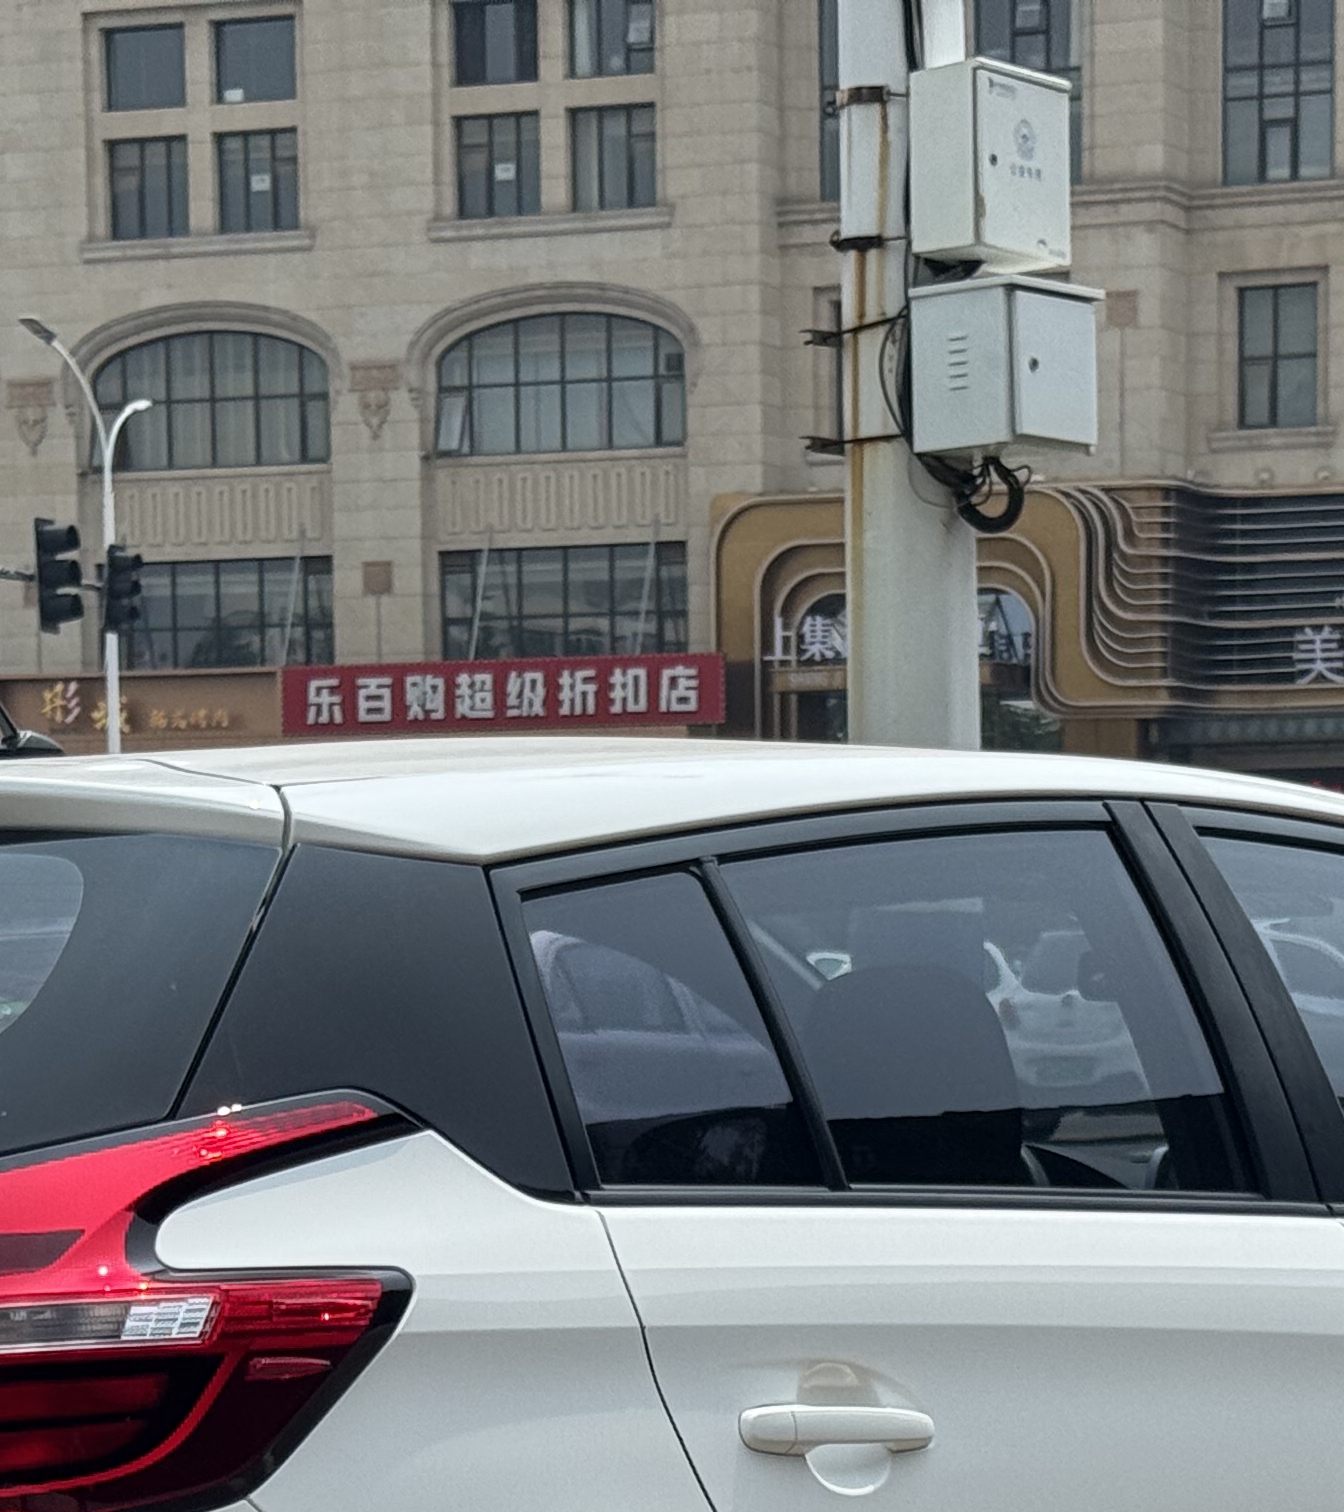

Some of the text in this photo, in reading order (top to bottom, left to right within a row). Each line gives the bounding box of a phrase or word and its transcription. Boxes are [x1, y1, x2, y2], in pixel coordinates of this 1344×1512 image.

[307, 665, 701, 726] 乐百购超级折扣店
